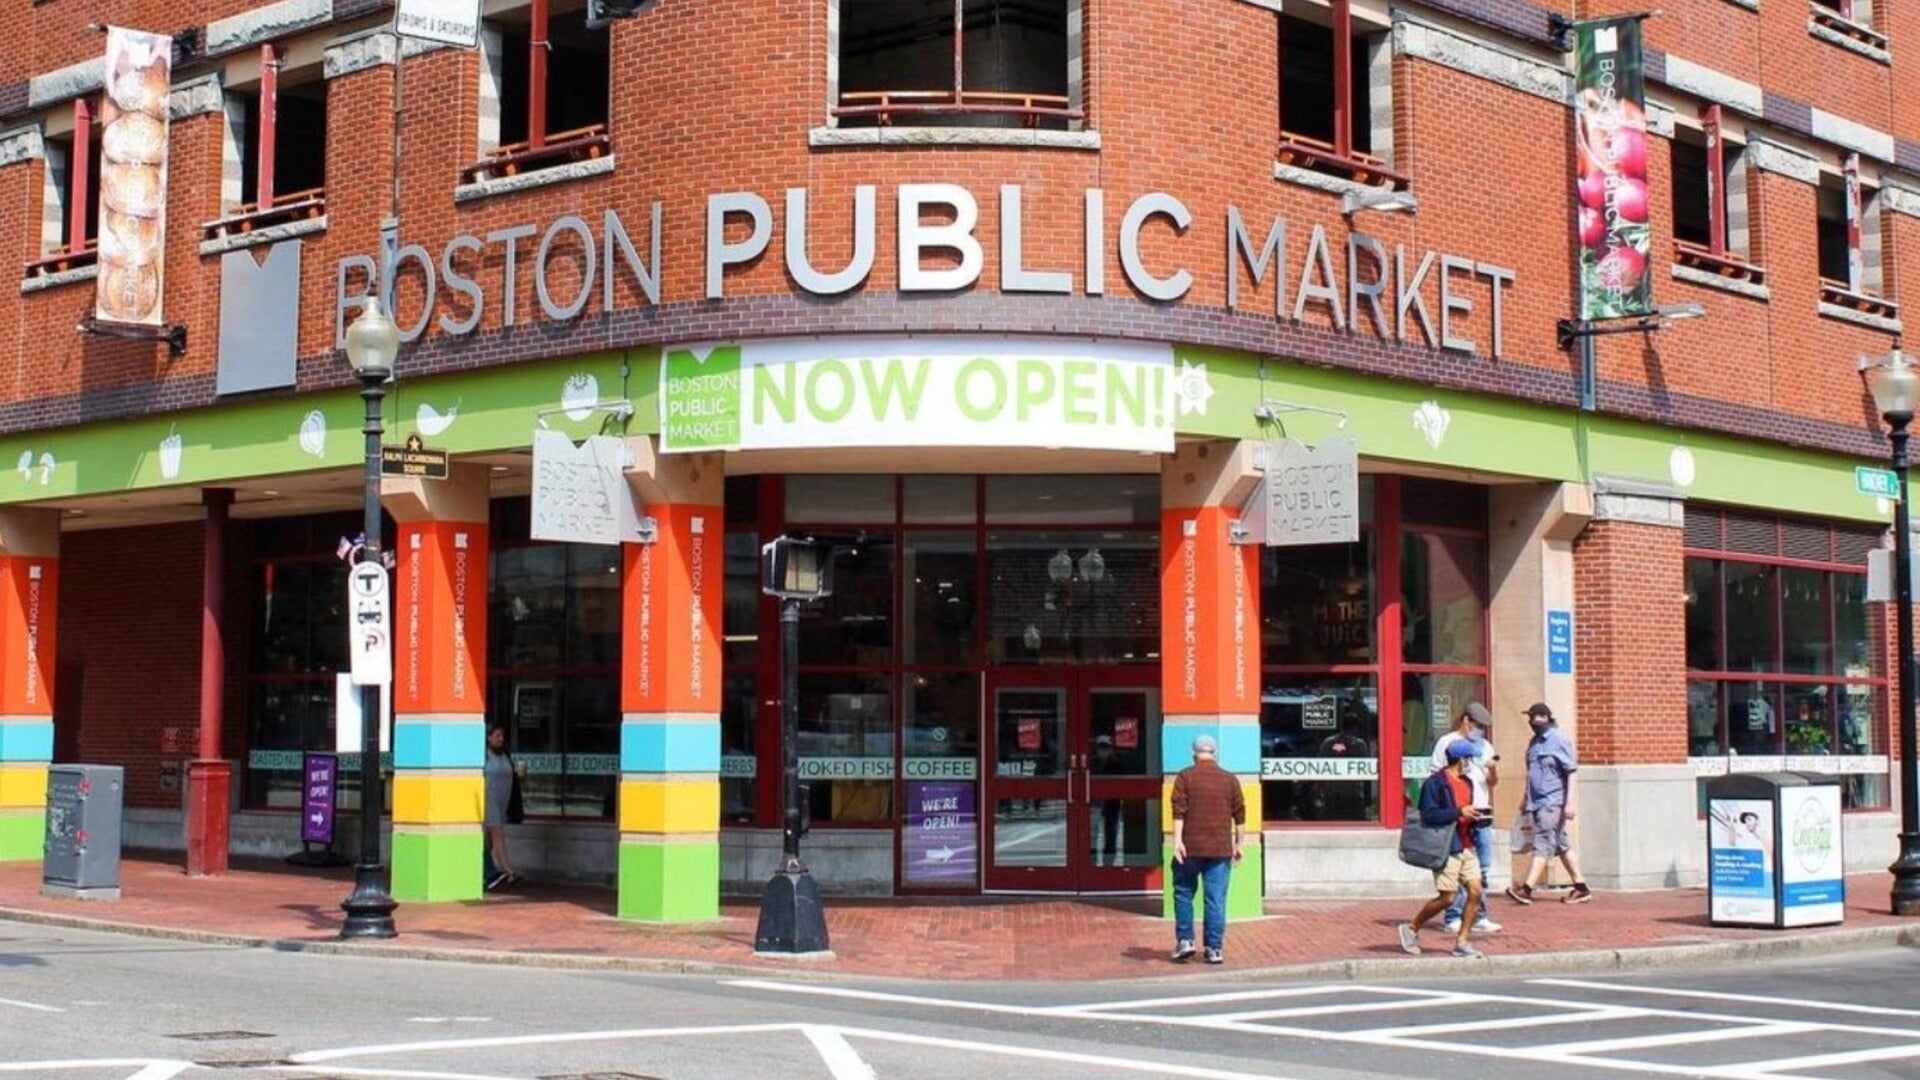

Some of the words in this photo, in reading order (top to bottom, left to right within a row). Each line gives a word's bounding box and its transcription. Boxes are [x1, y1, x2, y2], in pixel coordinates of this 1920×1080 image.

[335, 200, 661, 350] BOSTON
[706, 183, 1193, 300] PUBLIC
[1226, 204, 1515, 357] MARKET
[668, 374, 737, 394] BOSTON
[752, 357, 933, 426] NOW
[954, 357, 1165, 427] OPEN!
[670, 397, 727, 417] PUBLIC
[669, 420, 737, 440] MARKET
[1272, 491, 1342, 510] PUBLIC
[641, 547, 650, 592] OSTON
[1235, 546, 1243, 593] OSTON
[358, 573, 379, 591] T
[410, 604, 419, 649] PUBLIC
[455, 604, 465, 649] PUBLIC
[691, 595, 701, 643] PUBLIC
[1185, 596, 1195, 645] PUBLIC
[797, 761, 856, 775] MOKED
[906, 761, 973, 776] COFFEE
[1262, 761, 1342, 776] EASONAL
[923, 815, 960, 830] OPEN!
